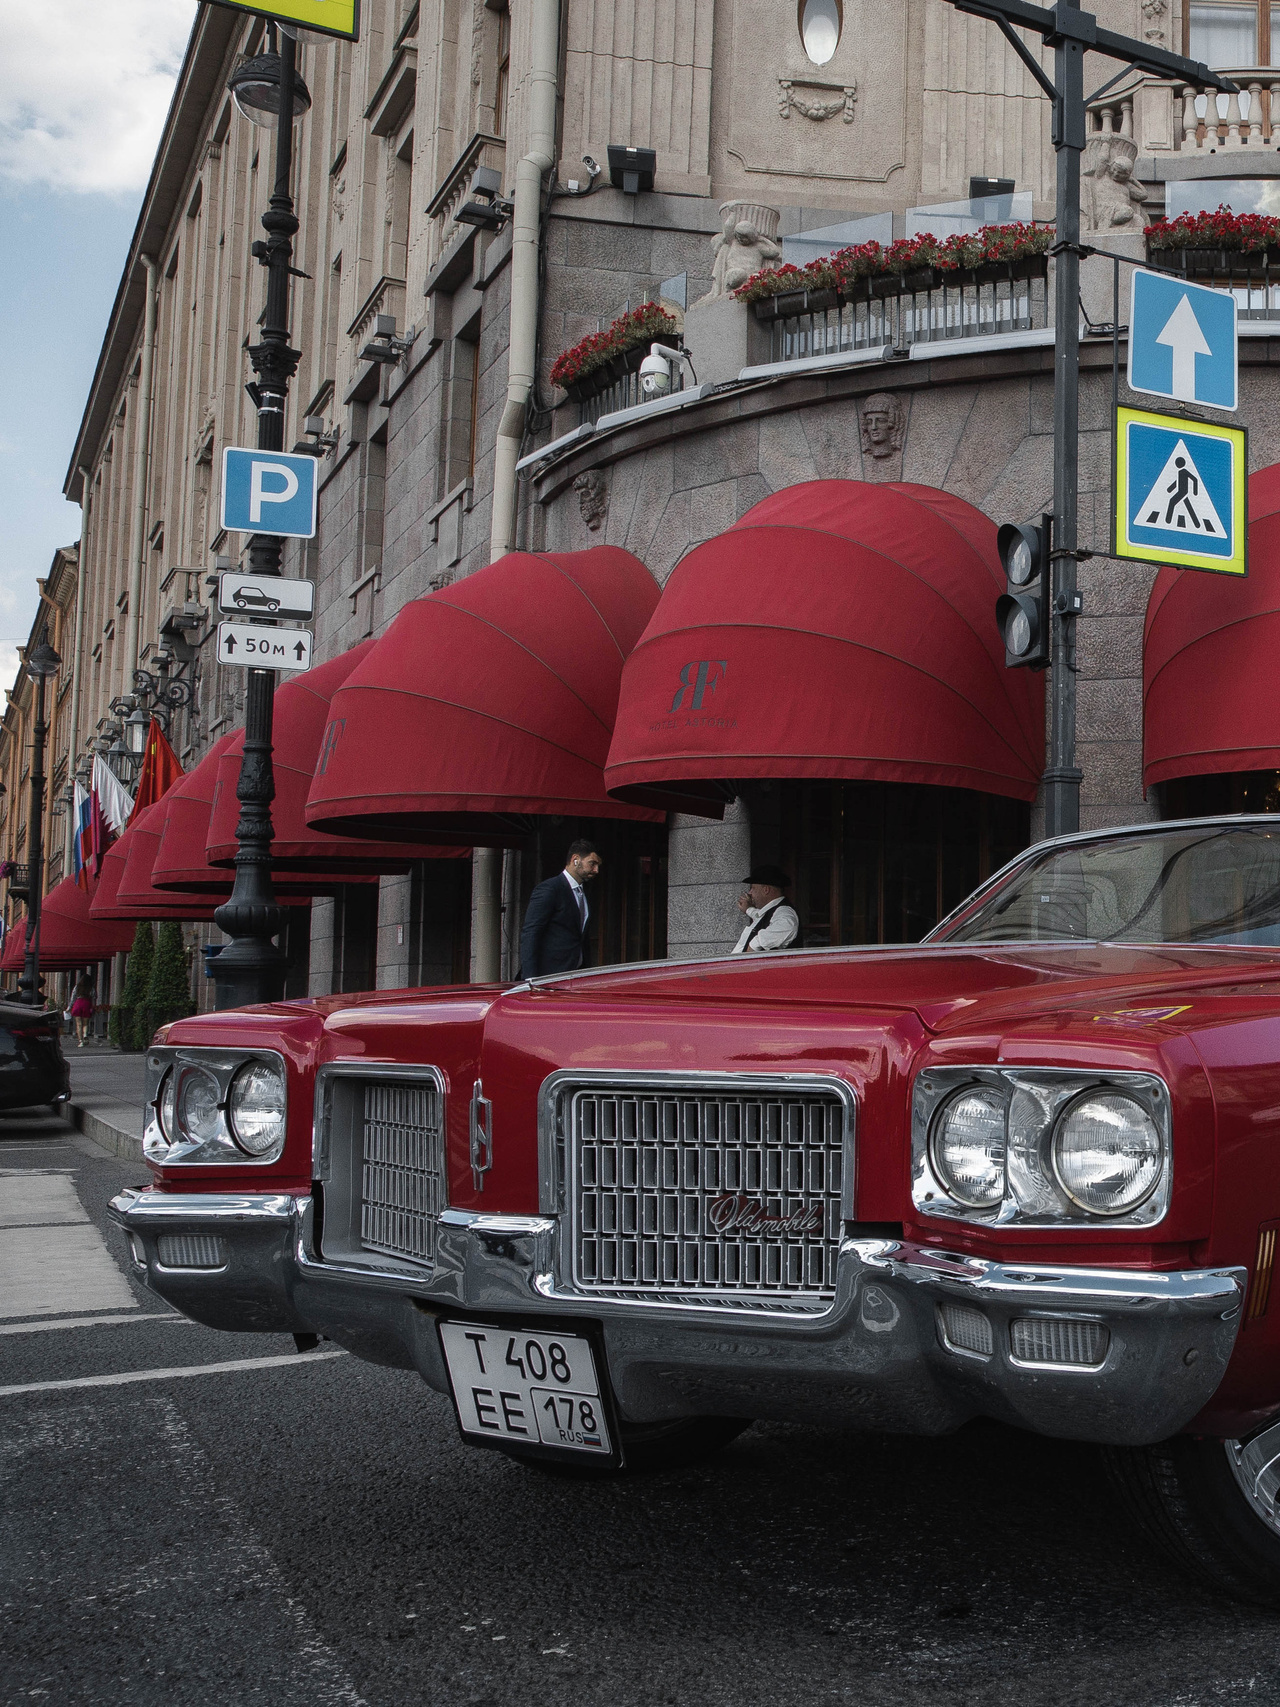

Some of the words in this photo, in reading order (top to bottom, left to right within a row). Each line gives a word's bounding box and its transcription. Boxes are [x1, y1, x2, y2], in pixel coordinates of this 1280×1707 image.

[250, 461, 299, 523] P
[685, 717, 738, 729] ASTORIA
[709, 1195, 821, 1233] Oldsmobile
[505, 1337, 572, 1384] 408
[543, 1395, 598, 1433] 178
[559, 1429, 584, 1444] RUS
